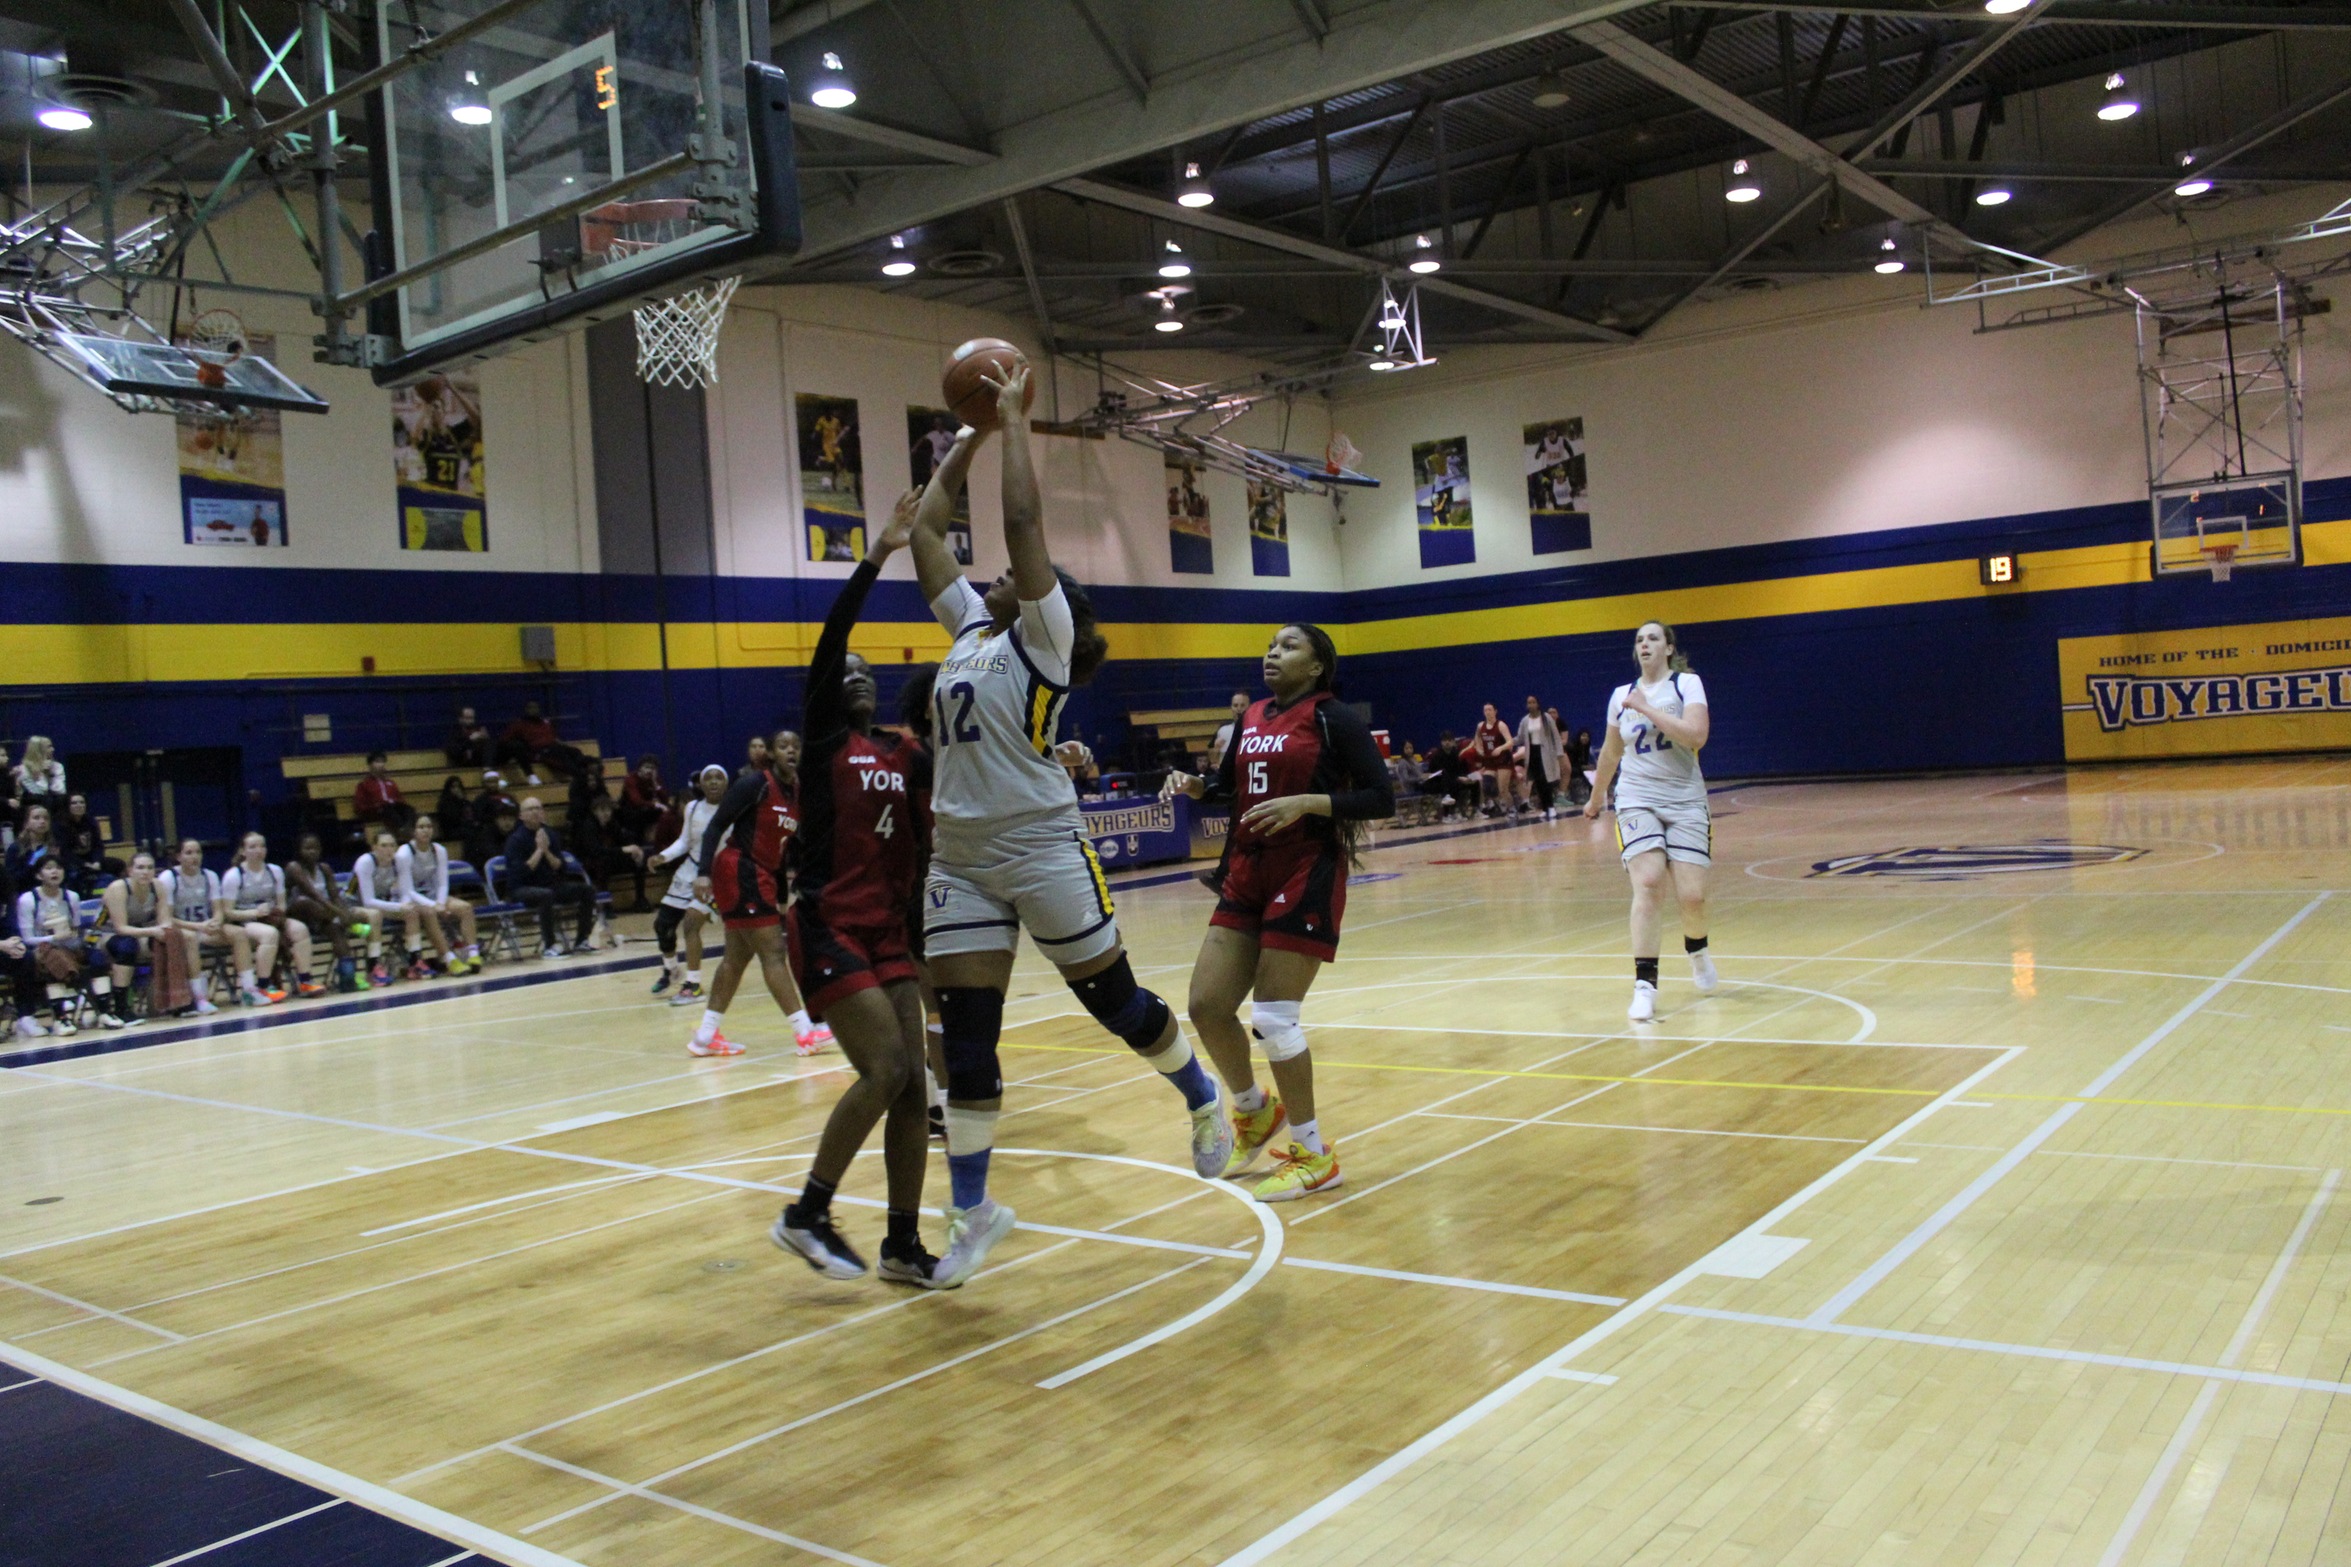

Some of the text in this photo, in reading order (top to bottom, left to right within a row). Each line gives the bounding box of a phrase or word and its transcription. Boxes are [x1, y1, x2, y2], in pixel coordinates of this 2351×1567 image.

[1990, 556, 2012, 582] 19
[2100, 653, 2157, 667] HOME
[2162, 651, 2188, 663] OF
[2196, 647, 2239, 660] THE
[935, 681, 981, 747] 12
[1239, 734, 1289, 755] YORK
[1247, 761, 1268, 795] 15
[874, 803, 895, 840] 4
[930, 887, 952, 909] V
